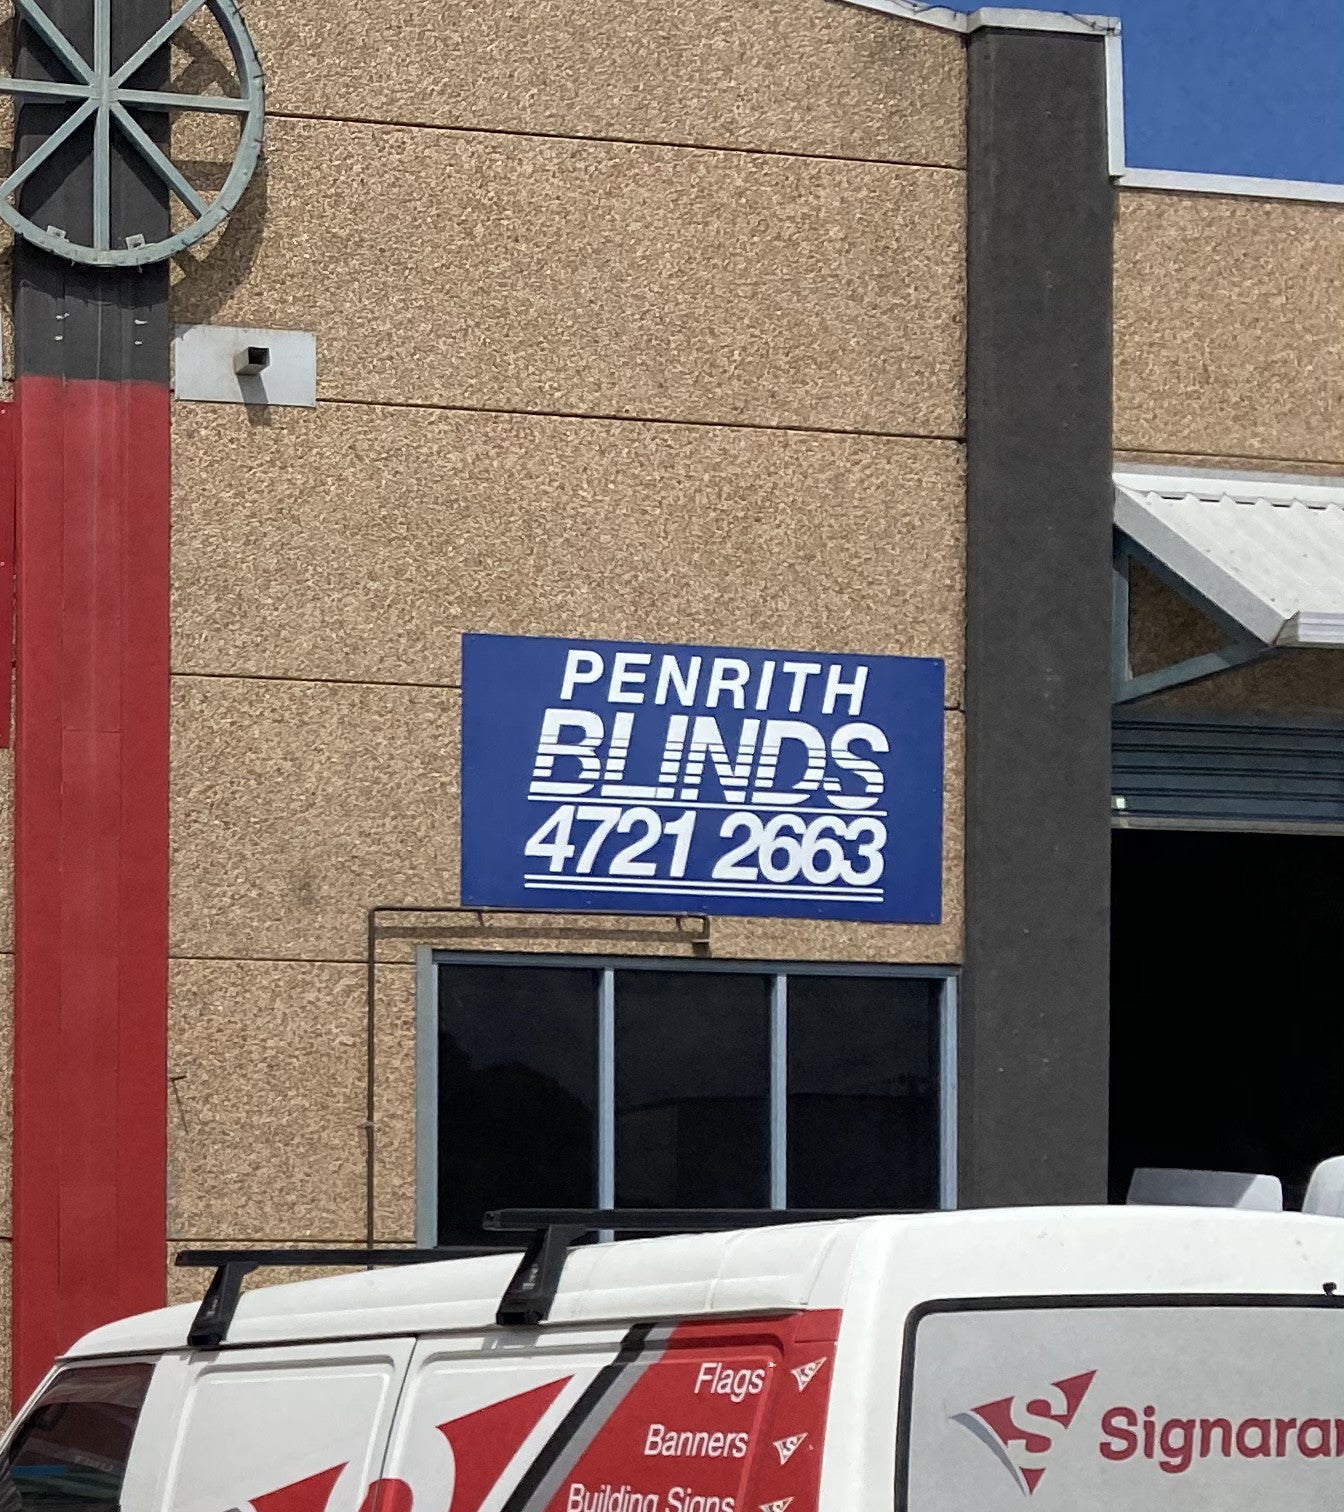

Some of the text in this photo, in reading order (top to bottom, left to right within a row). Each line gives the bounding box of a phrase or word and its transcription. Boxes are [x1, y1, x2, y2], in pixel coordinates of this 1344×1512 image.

[560, 649, 869, 716] PENRITH
[529, 707, 890, 810] BLINDS
[525, 804, 888, 886] 4721 2663
[694, 1361, 766, 1403] Flags
[644, 1423, 748, 1459] Banners
[1098, 1406, 1344, 1473] Signara
